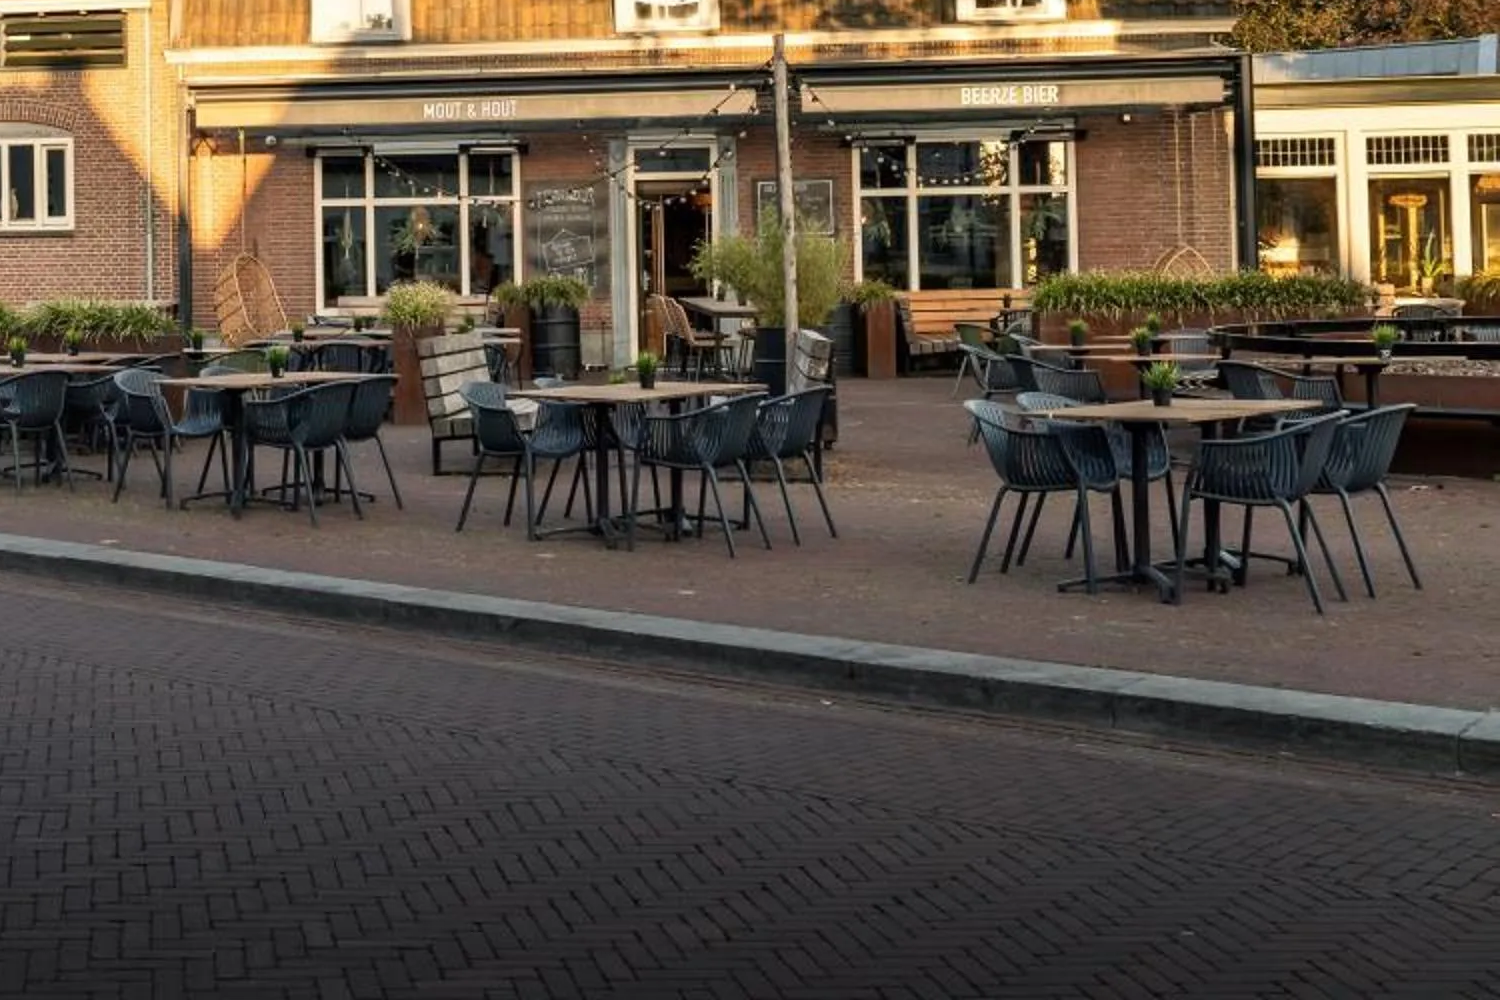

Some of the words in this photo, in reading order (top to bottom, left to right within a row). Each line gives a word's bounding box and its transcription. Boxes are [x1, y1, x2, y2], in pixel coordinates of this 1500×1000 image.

[961, 87, 1017, 104] BEERZE
[1023, 86, 1059, 103] BIER
[423, 101, 462, 119] MOUT
[467, 103, 477, 119] &
[481, 100, 517, 117] HOUT
